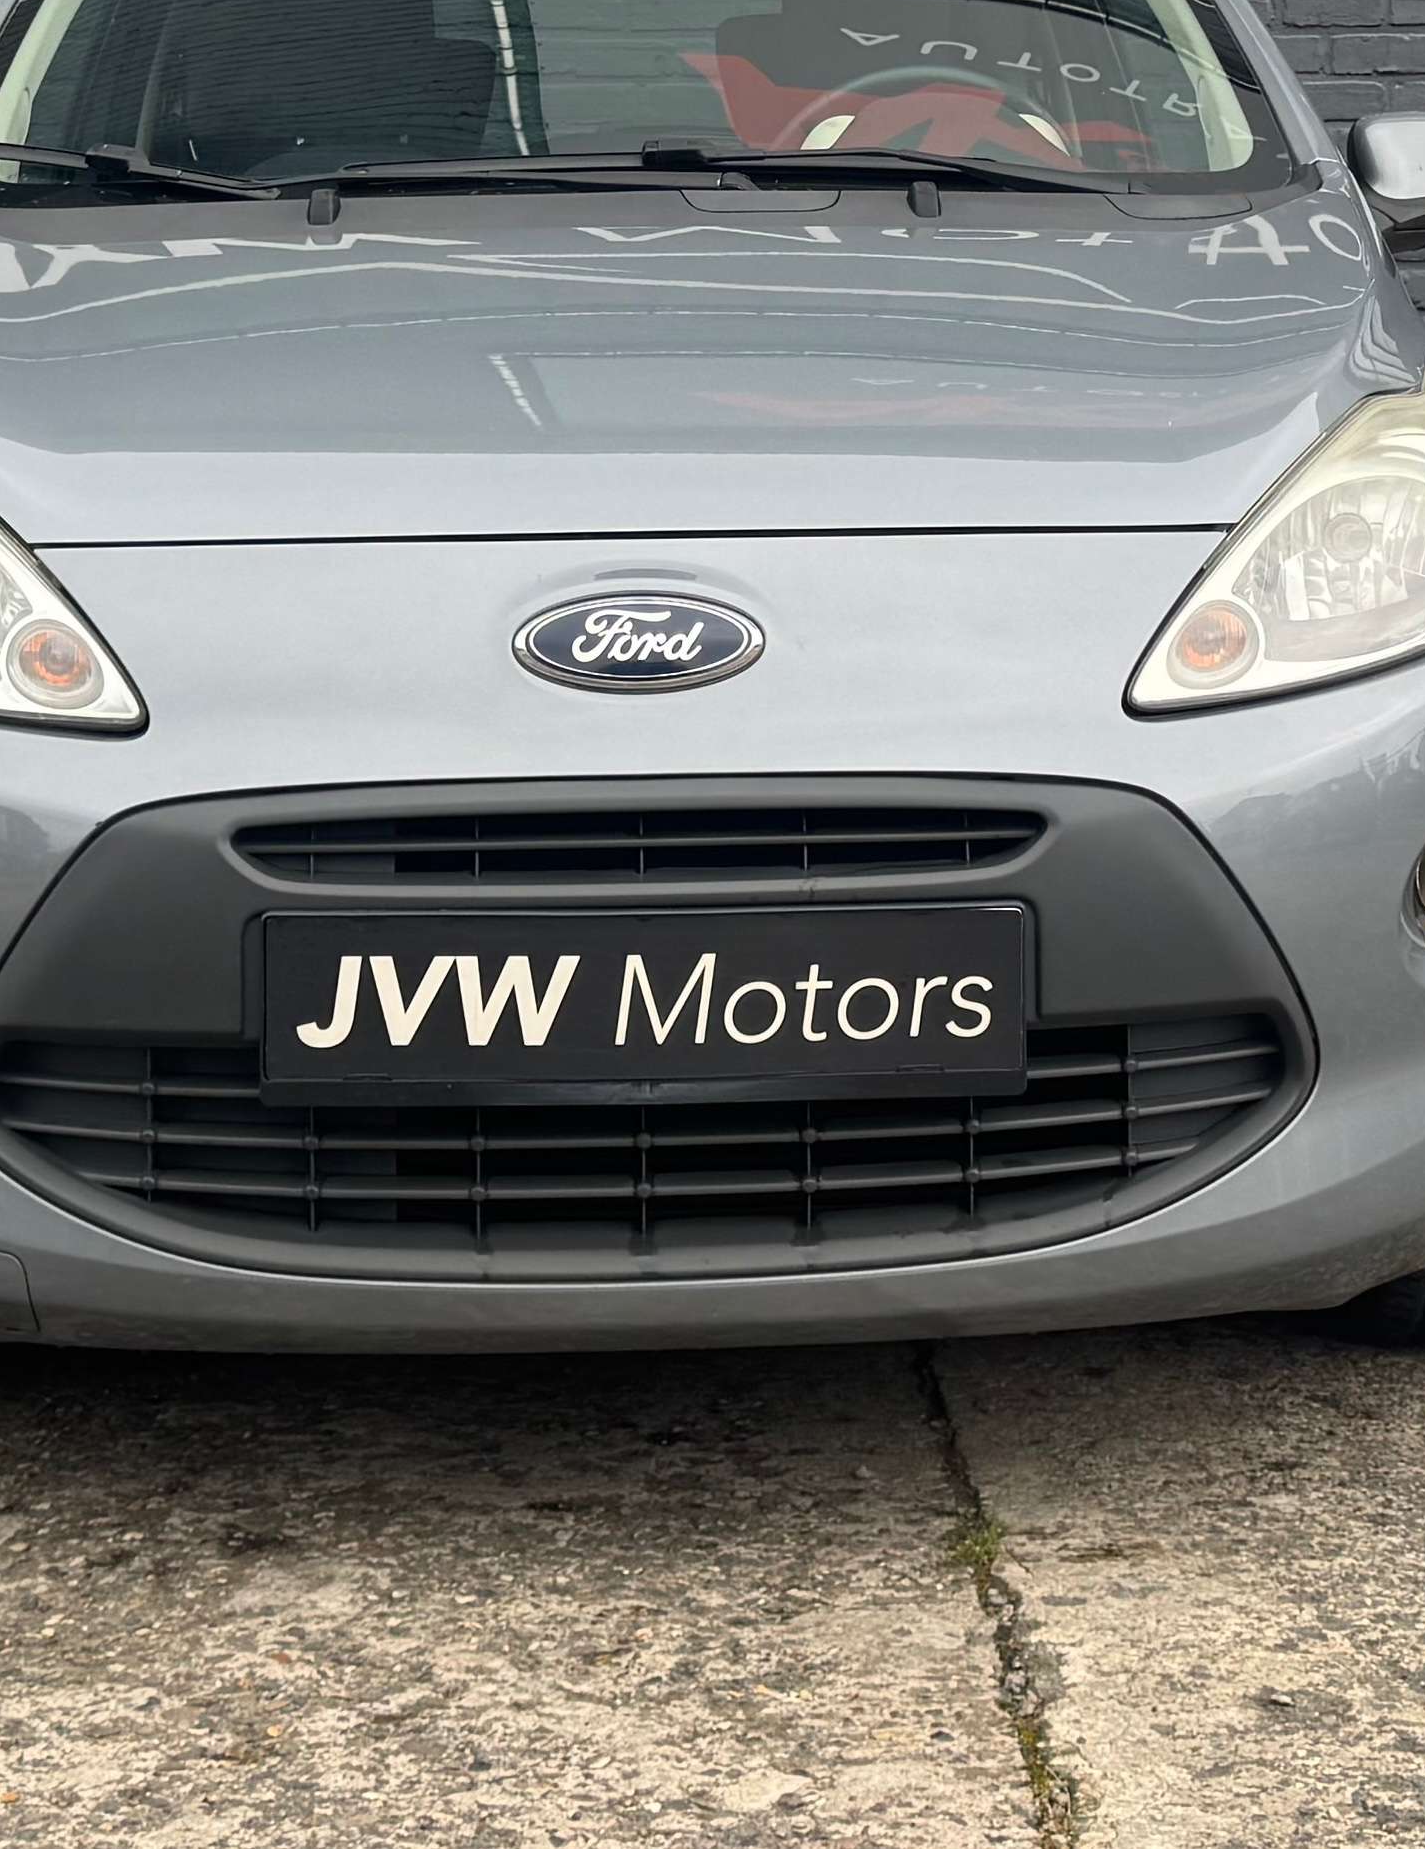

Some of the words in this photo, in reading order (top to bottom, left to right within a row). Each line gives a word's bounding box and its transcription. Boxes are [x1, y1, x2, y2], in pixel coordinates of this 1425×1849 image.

[571, 609, 705, 663] Ford
[295, 955, 581, 1049] JVW
[614, 952, 994, 1046] Motors
